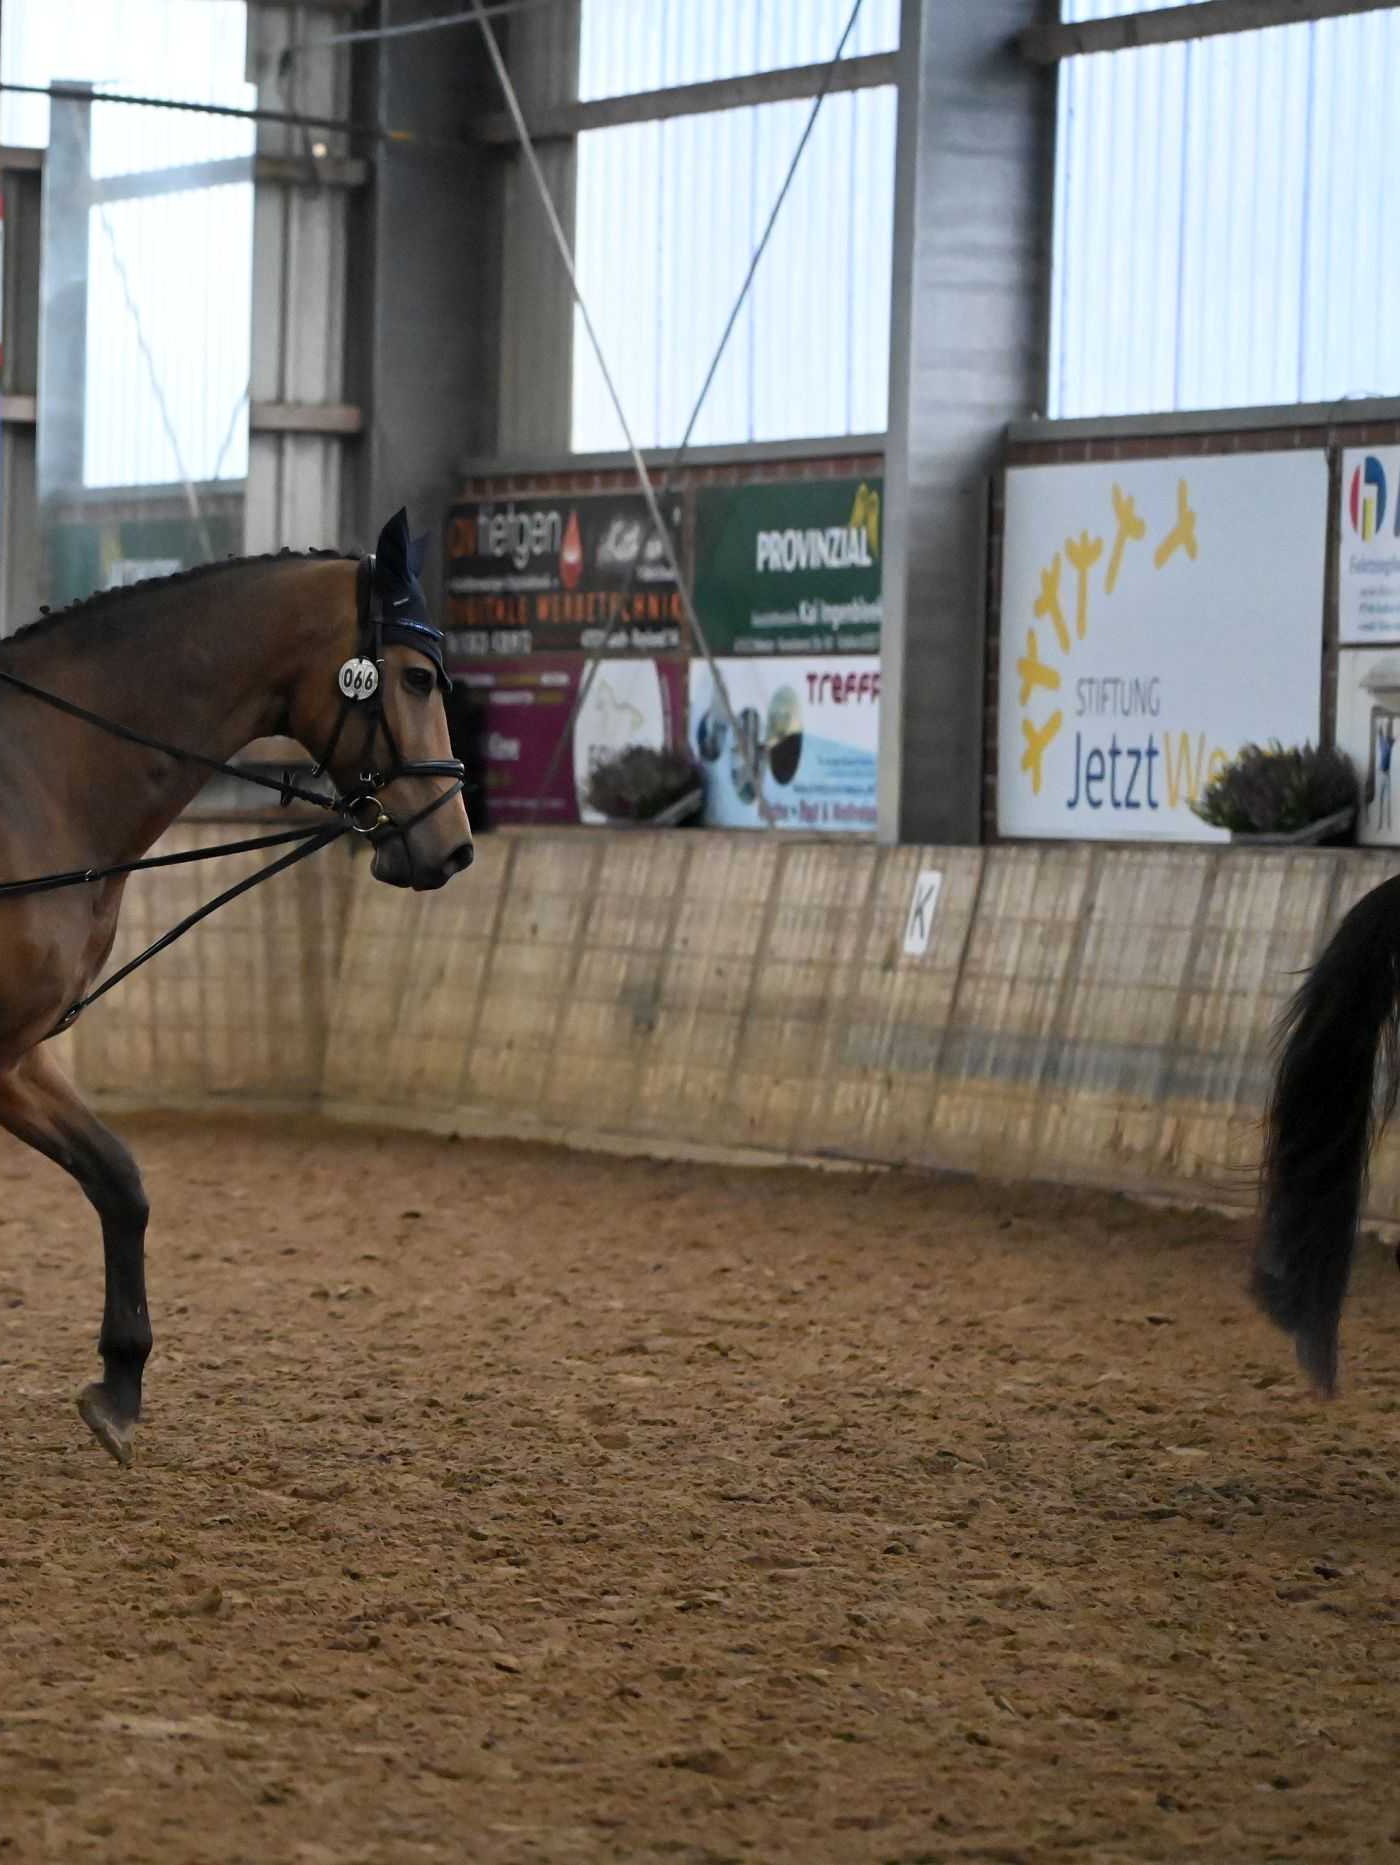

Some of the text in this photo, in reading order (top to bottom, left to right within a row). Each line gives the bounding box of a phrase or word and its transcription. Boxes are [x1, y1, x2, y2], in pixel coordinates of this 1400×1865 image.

[756, 526, 873, 573] PROVINZIAL
[343, 667, 374, 691] 066
[1075, 676, 1161, 718] STIFTUNG
[910, 884, 935, 940] K
